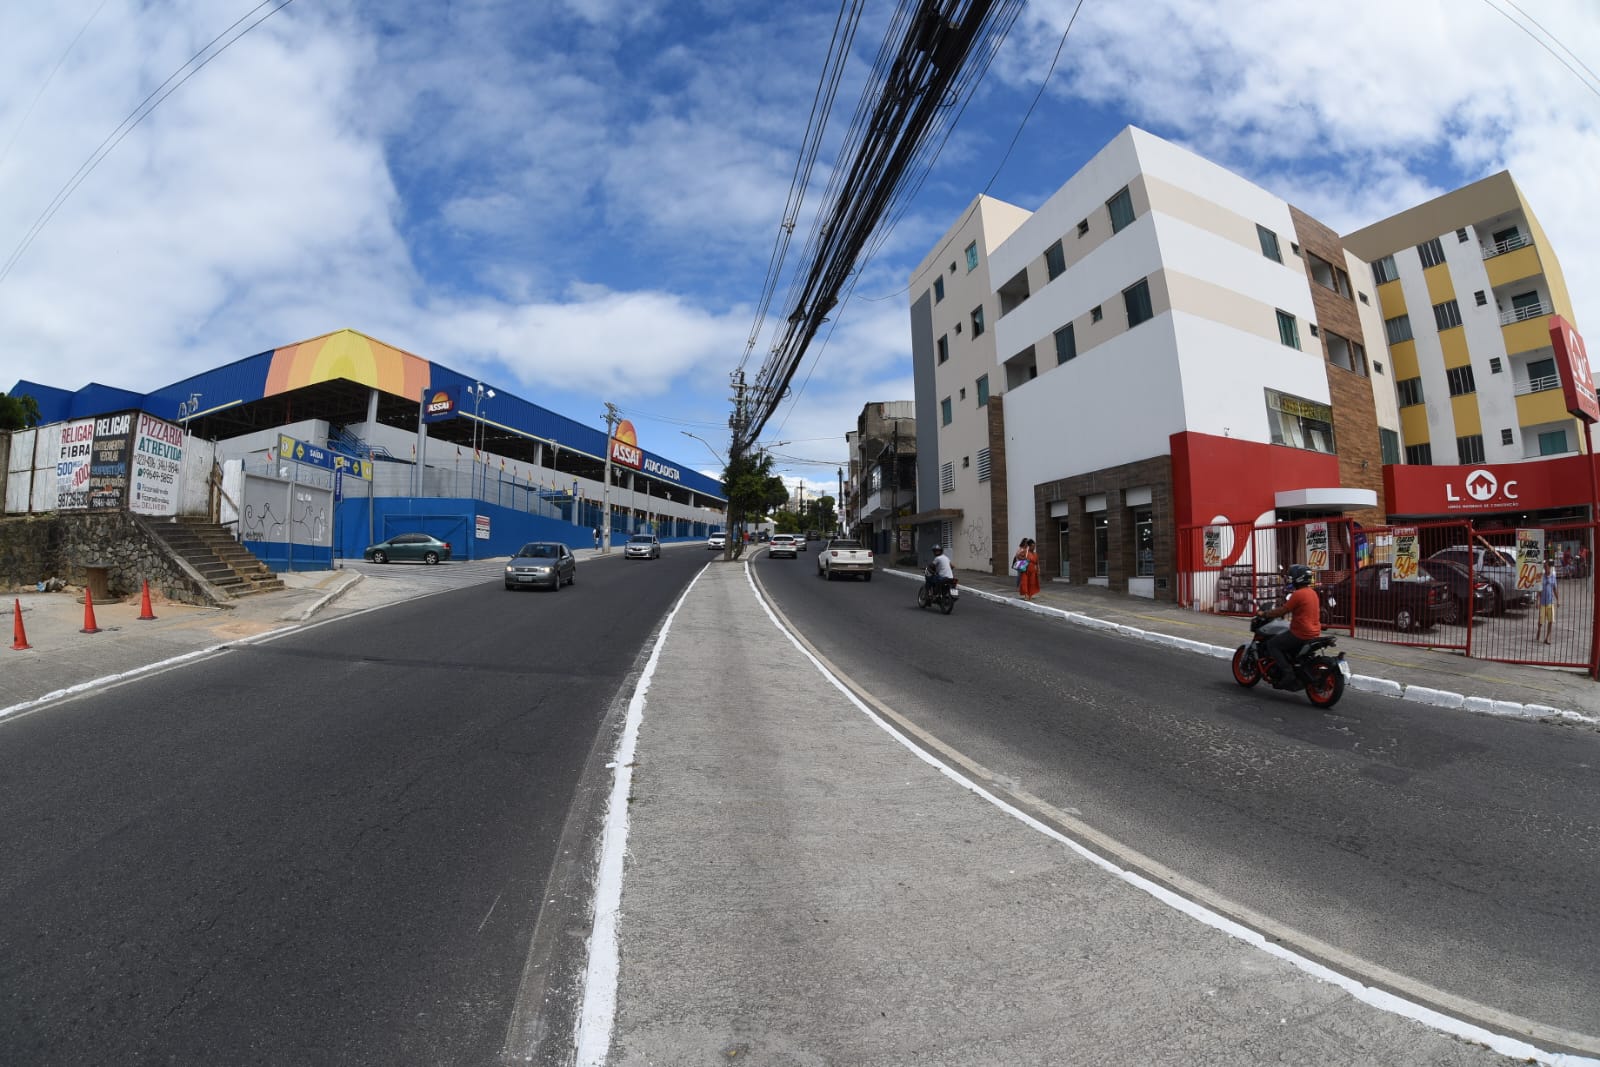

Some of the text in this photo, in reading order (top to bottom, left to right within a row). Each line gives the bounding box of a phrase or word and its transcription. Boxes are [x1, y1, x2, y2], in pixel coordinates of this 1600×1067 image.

[61, 424, 93, 444] RELIGAR
[96, 415, 130, 437] RELIGAR
[140, 415, 183, 448] PIZZARIA
[61, 444, 90, 459] FIBRA
[138, 437, 182, 461] ATREVIDA
[57, 461, 73, 477] 500
[644, 458, 680, 481] ATACADISTA
